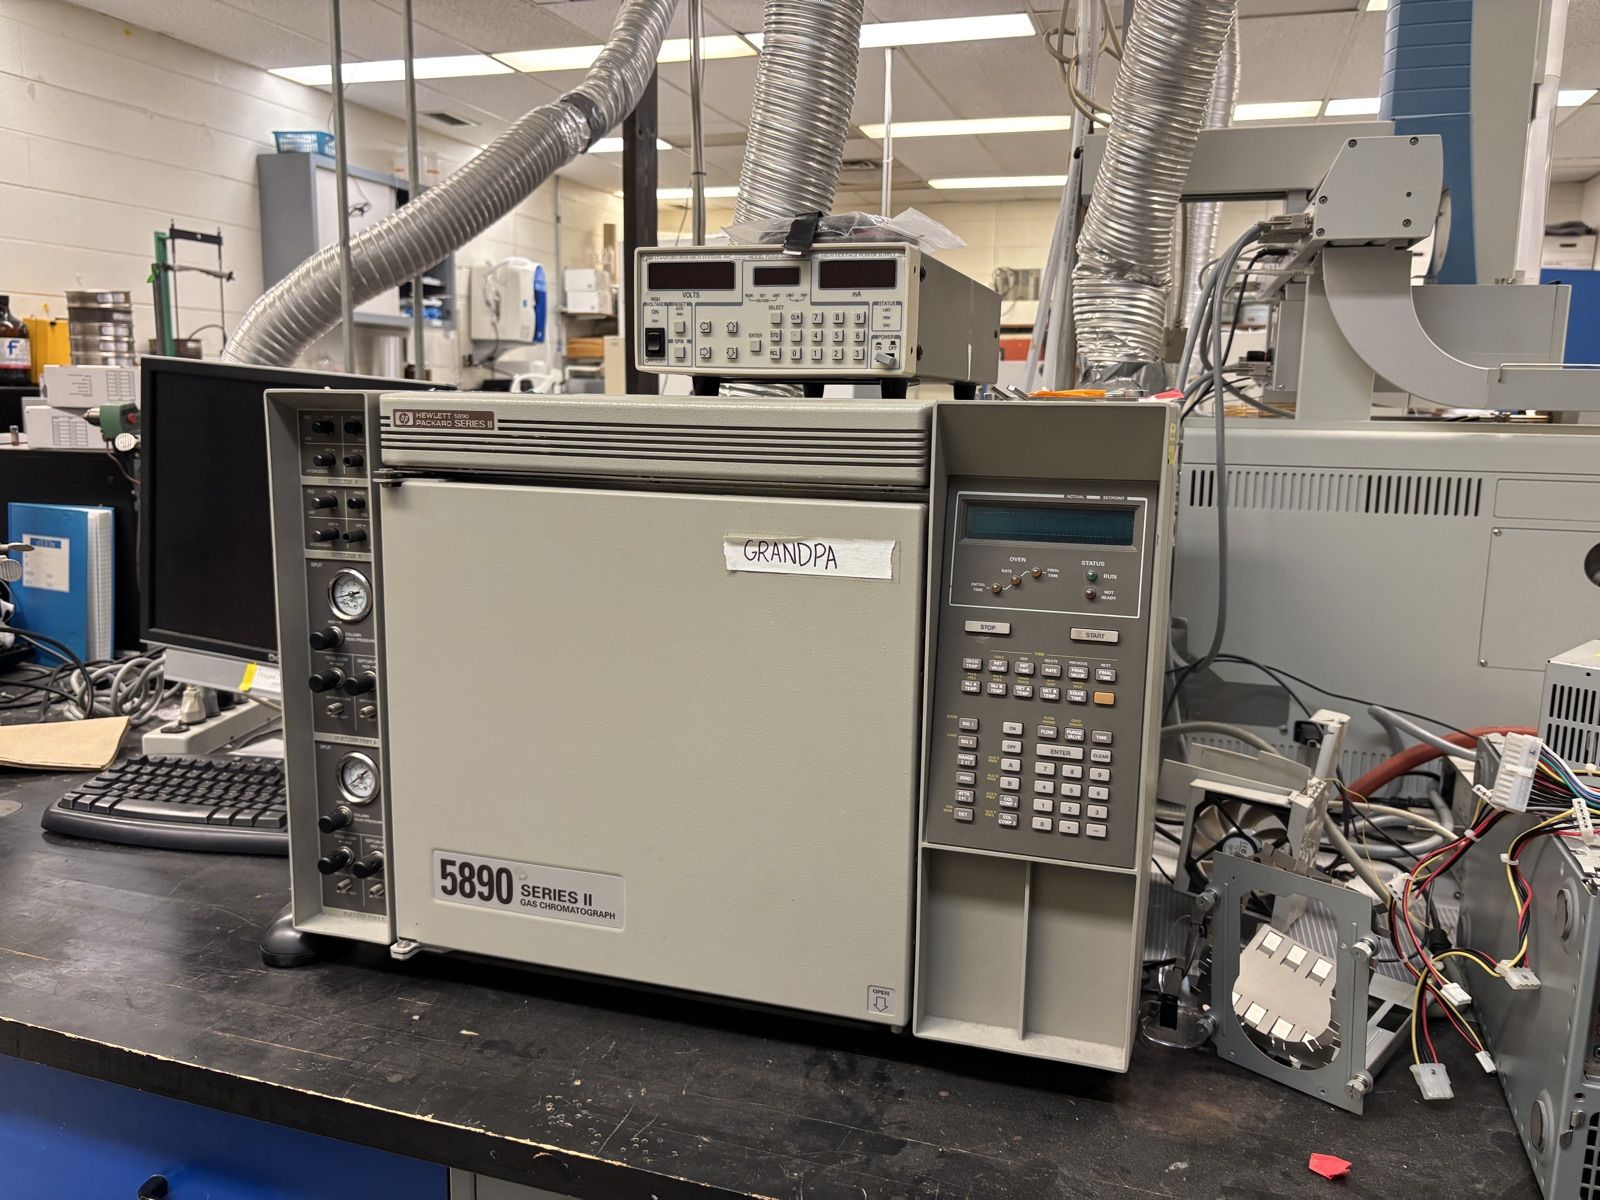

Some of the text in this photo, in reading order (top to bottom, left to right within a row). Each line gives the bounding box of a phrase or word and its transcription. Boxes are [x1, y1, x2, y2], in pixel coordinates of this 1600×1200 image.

[682, 291, 701, 299] VOLTS
[454, 420, 486, 428] SERIES
[743, 539, 838, 570] GRANDPA
[440, 858, 514, 905] 5890
[520, 883, 593, 907] SERIES II
[520, 898, 616, 921] GAS CHROMATOGRAPH
